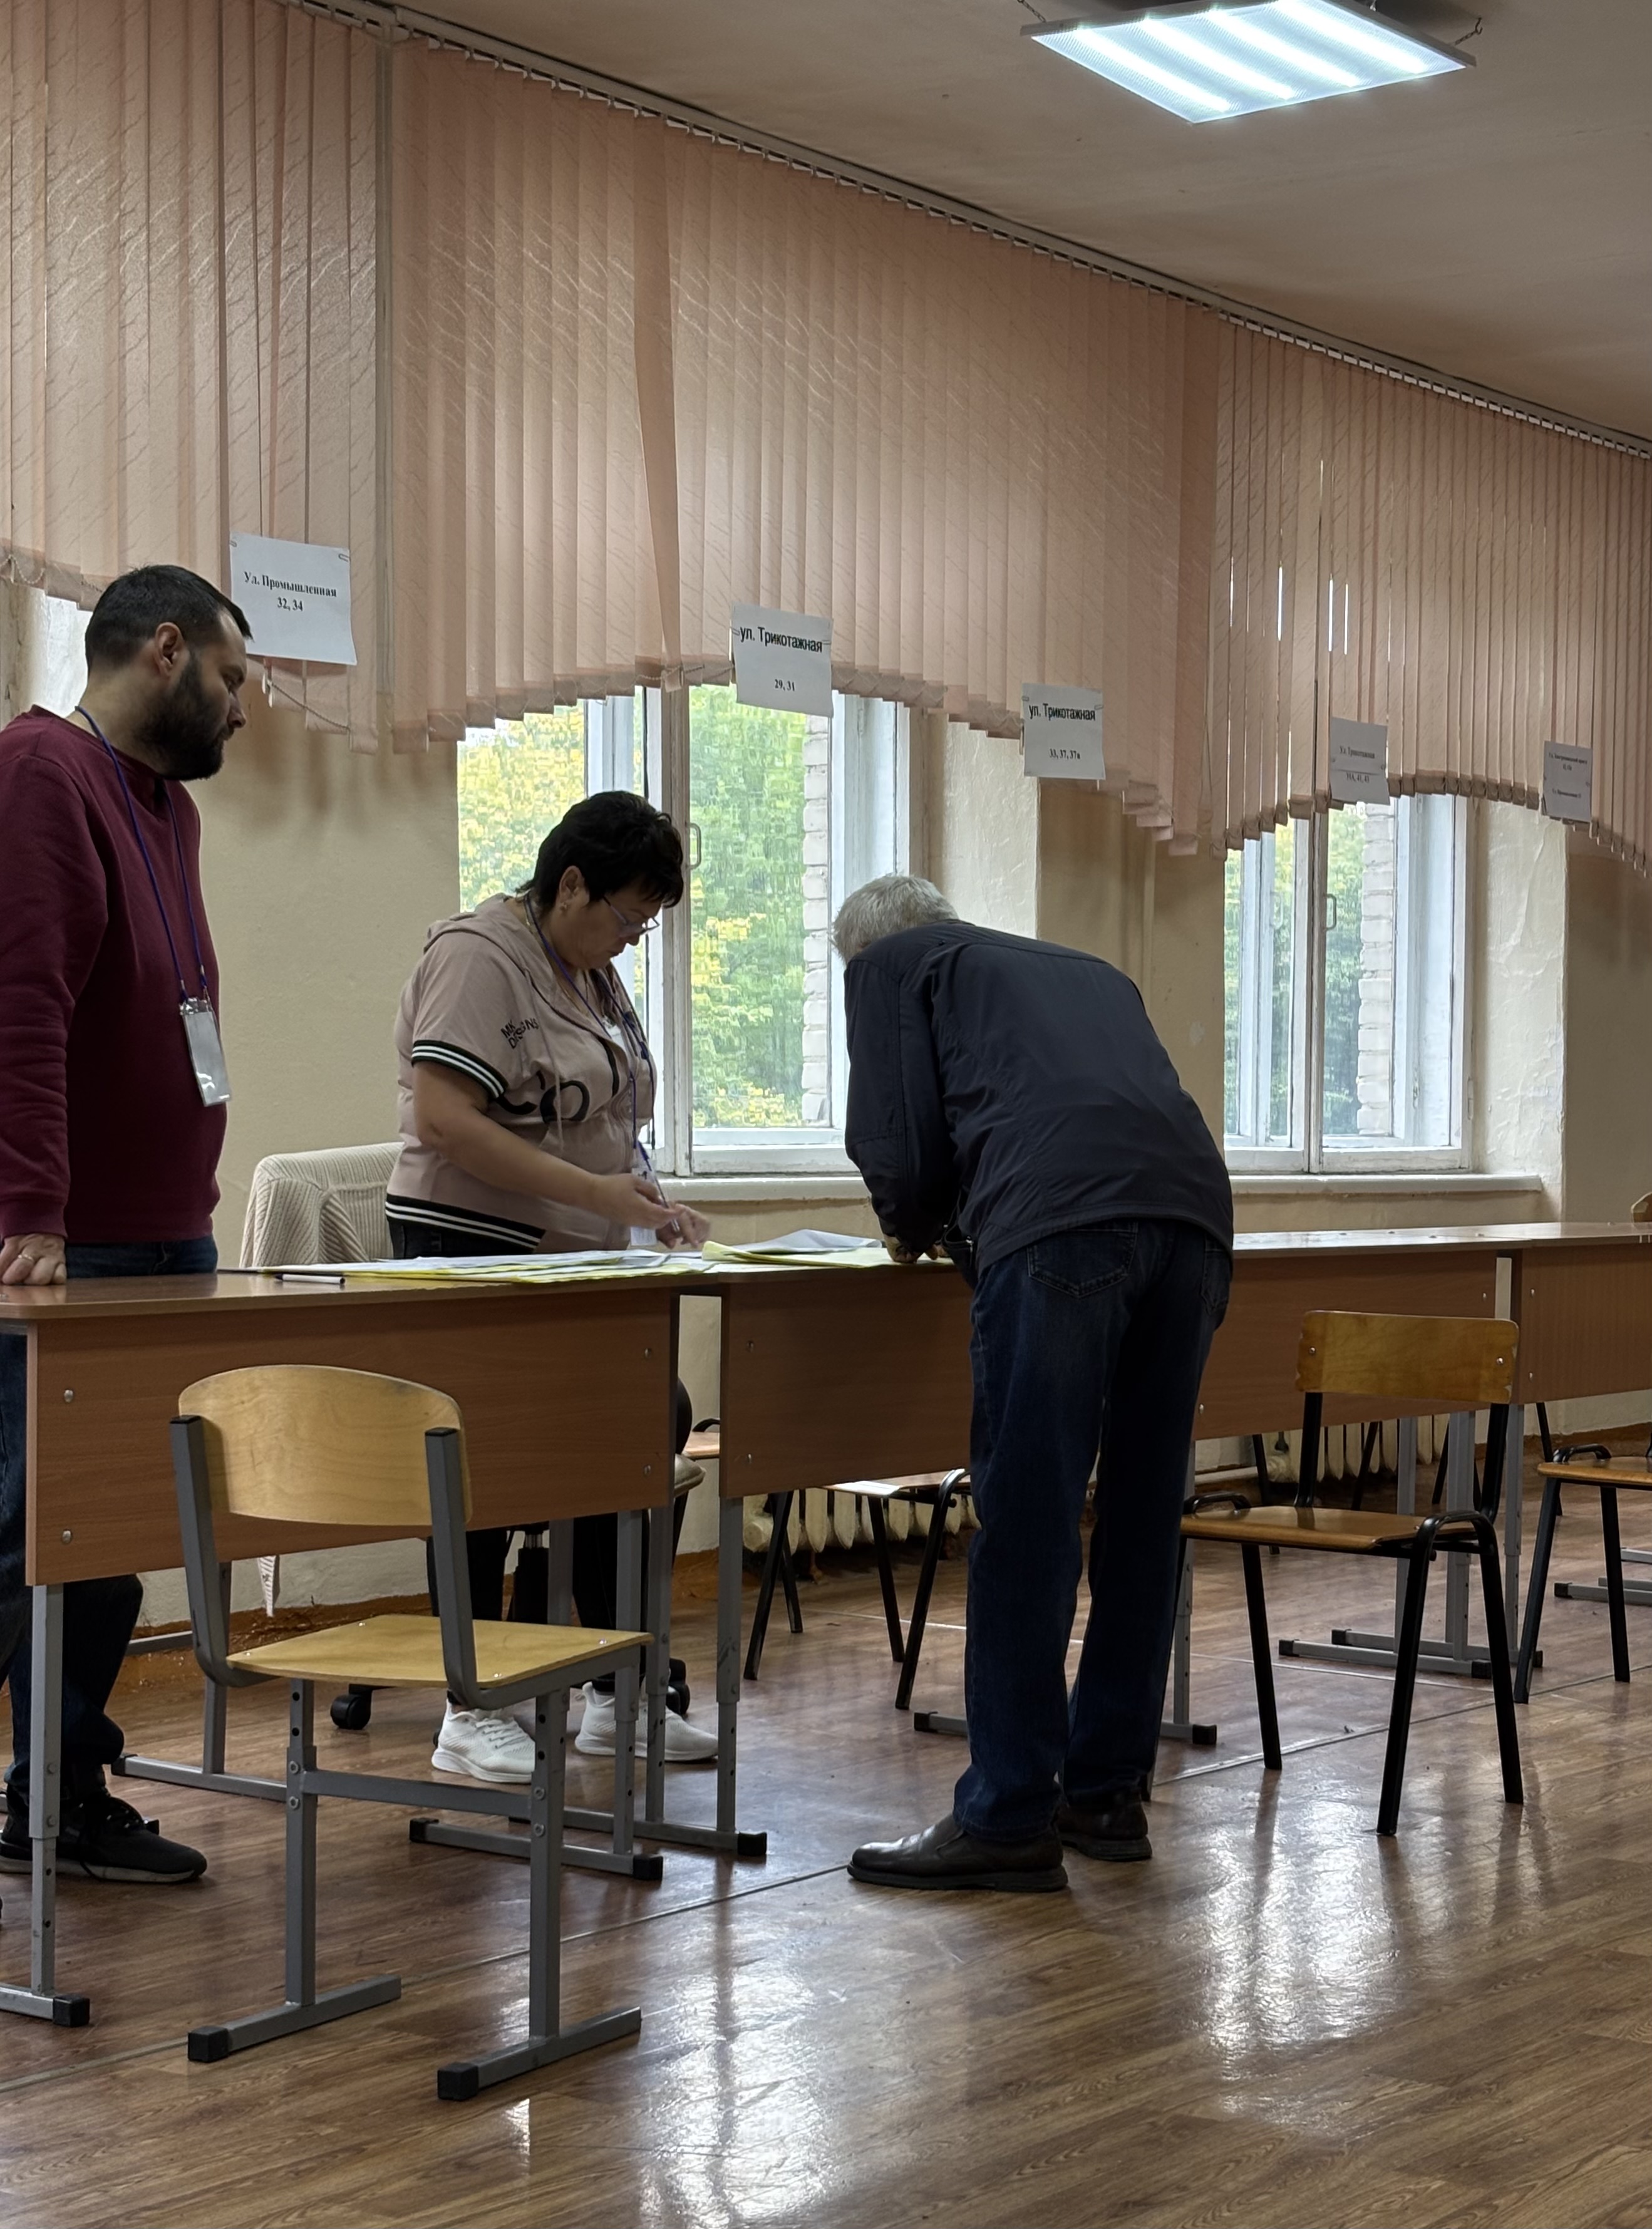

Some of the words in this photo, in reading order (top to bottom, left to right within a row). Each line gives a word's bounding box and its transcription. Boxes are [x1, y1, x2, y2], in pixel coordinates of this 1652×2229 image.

[244, 571, 260, 586] Ул.
[262, 574, 337, 597] Промышленная
[277, 597, 291, 612] 32,
[292, 599, 304, 612] 34
[740, 626, 756, 643] ул.
[757, 626, 823, 653] Трикотажная
[787, 680, 795, 692] 31
[1028, 705, 1041, 720] ул.
[1042, 703, 1096, 721] Трикотажная
